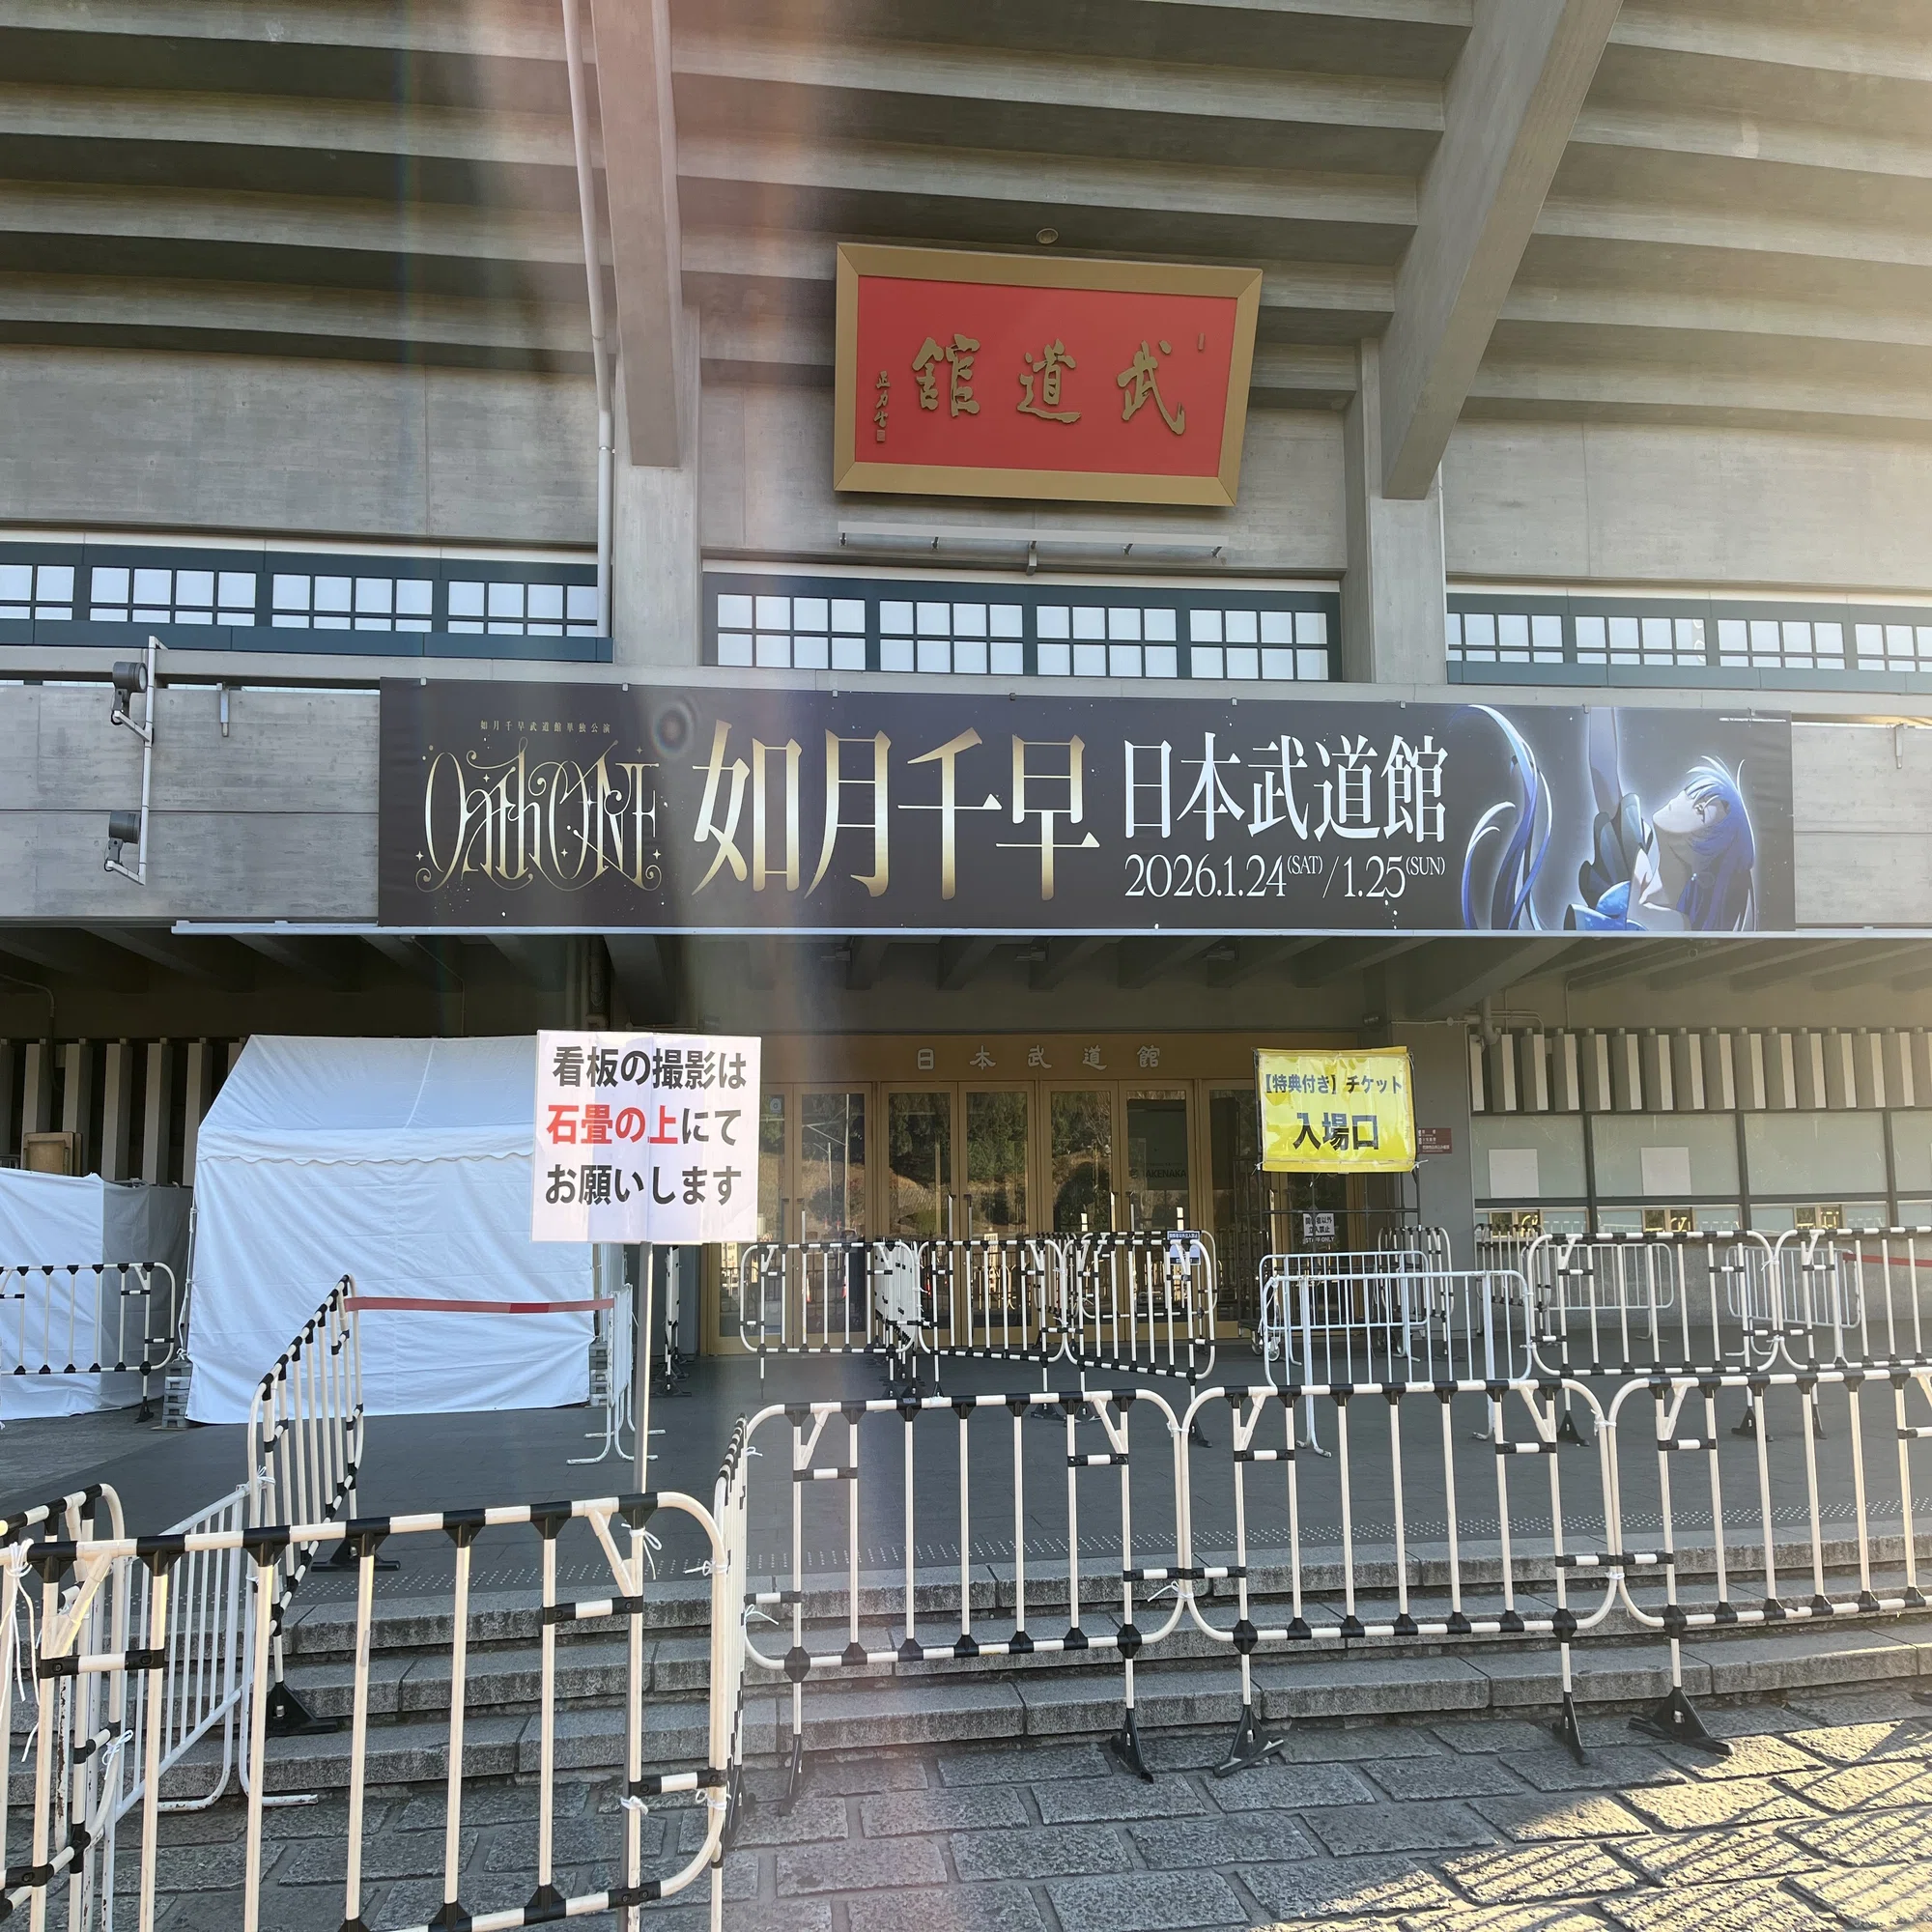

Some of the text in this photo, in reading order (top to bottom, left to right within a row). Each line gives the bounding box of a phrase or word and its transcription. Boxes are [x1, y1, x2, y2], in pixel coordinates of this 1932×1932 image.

[480, 720, 611, 733] 如月千早武道館単独公演
[1123, 731, 1448, 843] 日本武道館
[692, 720, 1101, 900] 如月千早
[553, 1045, 747, 1090] 看板の撮影は
[917, 1044, 1161, 1071] 日本武道館
[546, 1104, 742, 1147] 石畳の上にて
[1293, 1112, 1379, 1151] 入場口
[545, 1163, 742, 1206] お願いします
